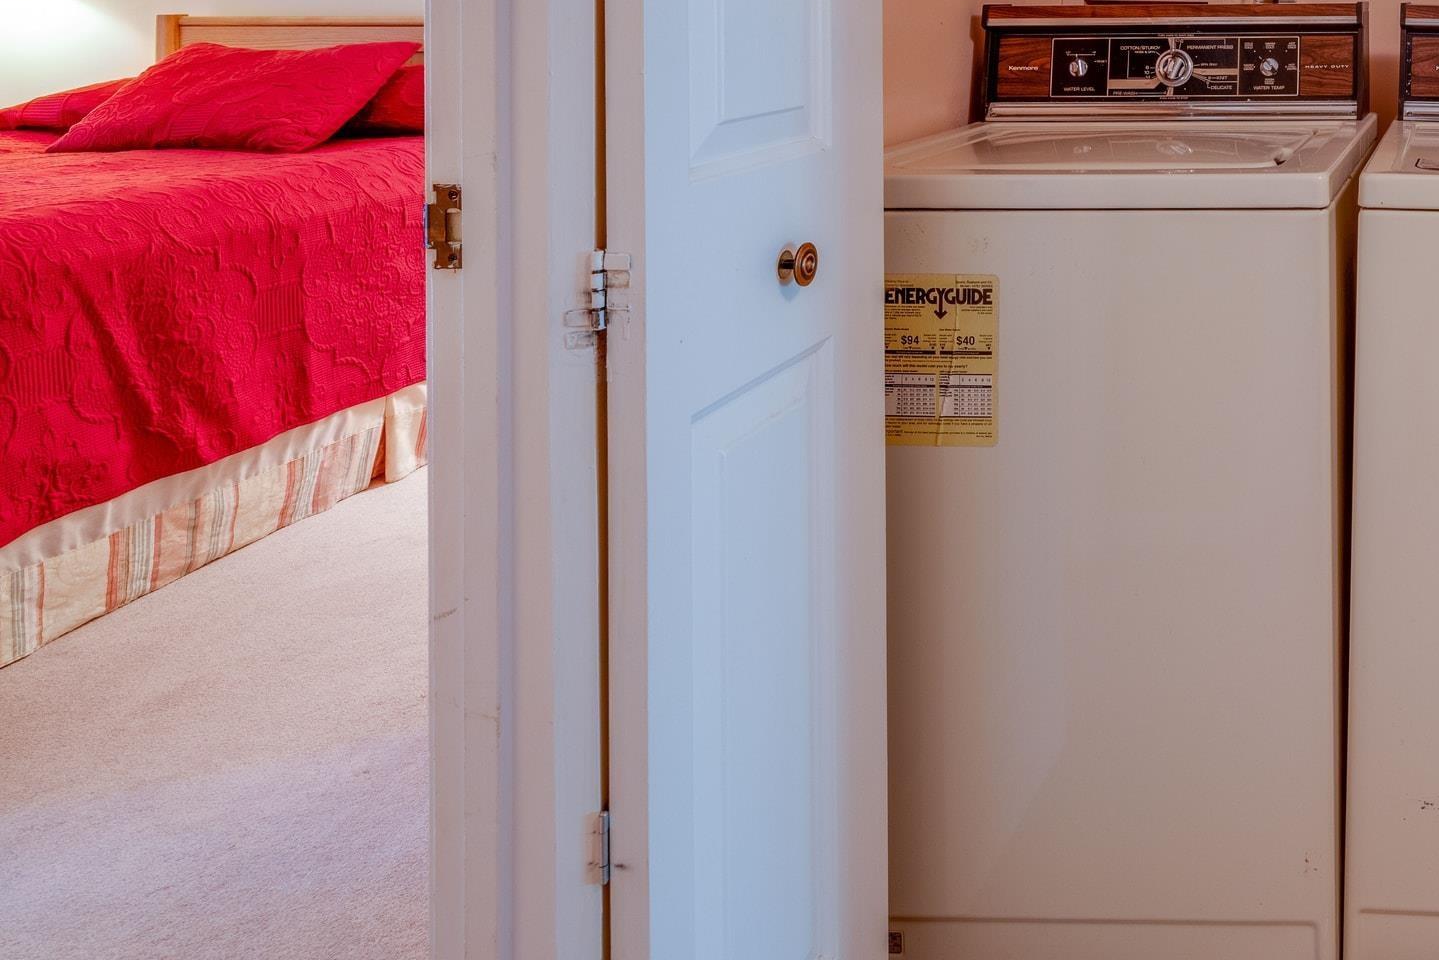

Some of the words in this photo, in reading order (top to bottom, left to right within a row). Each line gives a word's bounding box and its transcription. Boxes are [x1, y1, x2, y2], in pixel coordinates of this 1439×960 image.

[885, 288, 992, 306] ENERGYGUIDE
[900, 335, 919, 346] $94
[956, 335, 975, 346] $40
